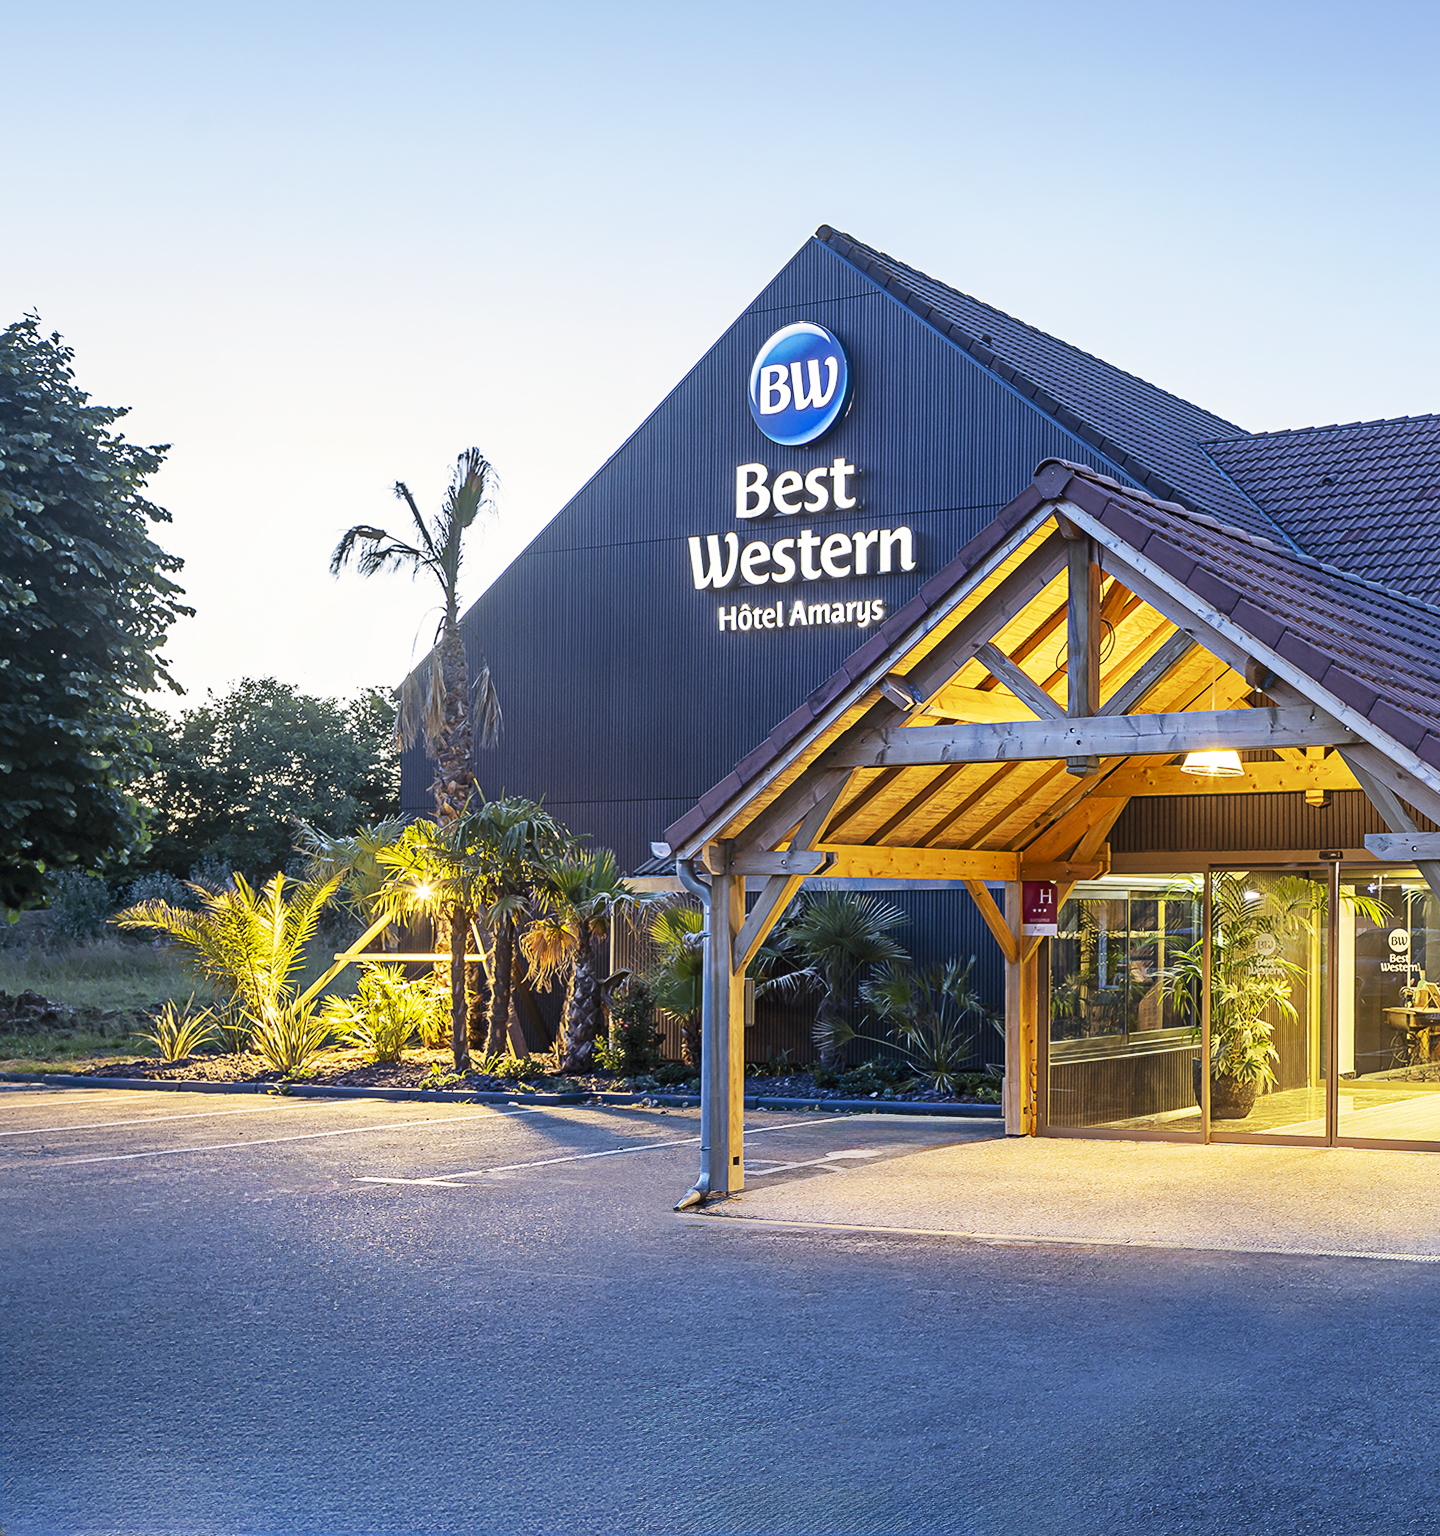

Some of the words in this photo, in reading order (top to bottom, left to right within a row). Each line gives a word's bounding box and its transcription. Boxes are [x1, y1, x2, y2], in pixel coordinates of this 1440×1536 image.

[759, 356, 838, 415] BW
[735, 458, 857, 519] Best
[688, 526, 917, 590] Western
[718, 601, 784, 632] Hôtel
[789, 599, 884, 628] Amarys
[1039, 888, 1053, 904] H
[1391, 936, 1408, 946] BW
[1380, 962, 1418, 972] Western
[1389, 953, 1410, 963] Best
